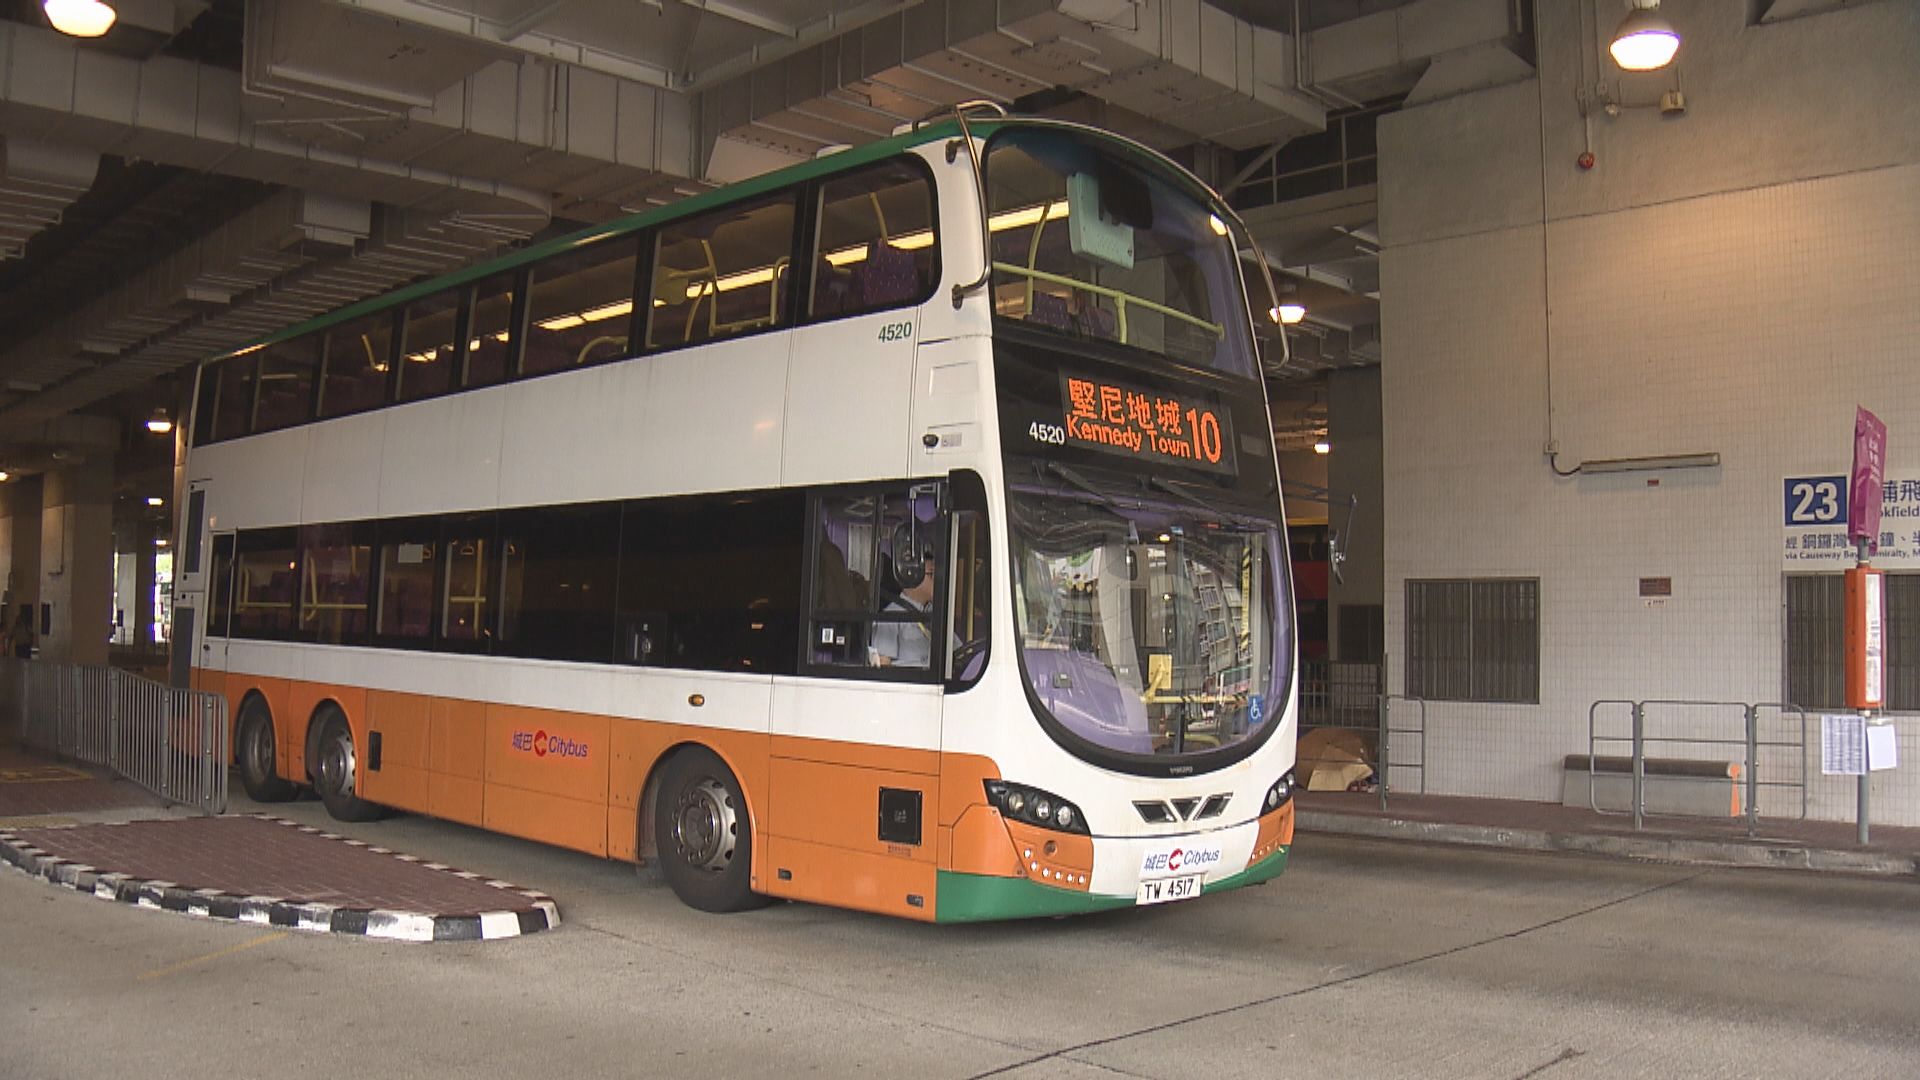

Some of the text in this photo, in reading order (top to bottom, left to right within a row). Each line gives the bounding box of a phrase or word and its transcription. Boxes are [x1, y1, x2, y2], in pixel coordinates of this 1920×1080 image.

[878, 321, 912, 342] 4520
[1068, 377, 1182, 435] 堅尼地城
[1029, 421, 1065, 446] 4520
[1066, 413, 1191, 459] Kennedy Town
[1186, 407, 1222, 464] 10
[1791, 481, 1839, 522] 23
[1785, 551, 1797, 560] via
[1800, 551, 1841, 561] Causeway
[548, 735, 588, 758] Citybus
[1144, 853, 1168, 871] 城巴
[1183, 848, 1220, 866] Citybus
[1145, 878, 1194, 900] TW 4517
